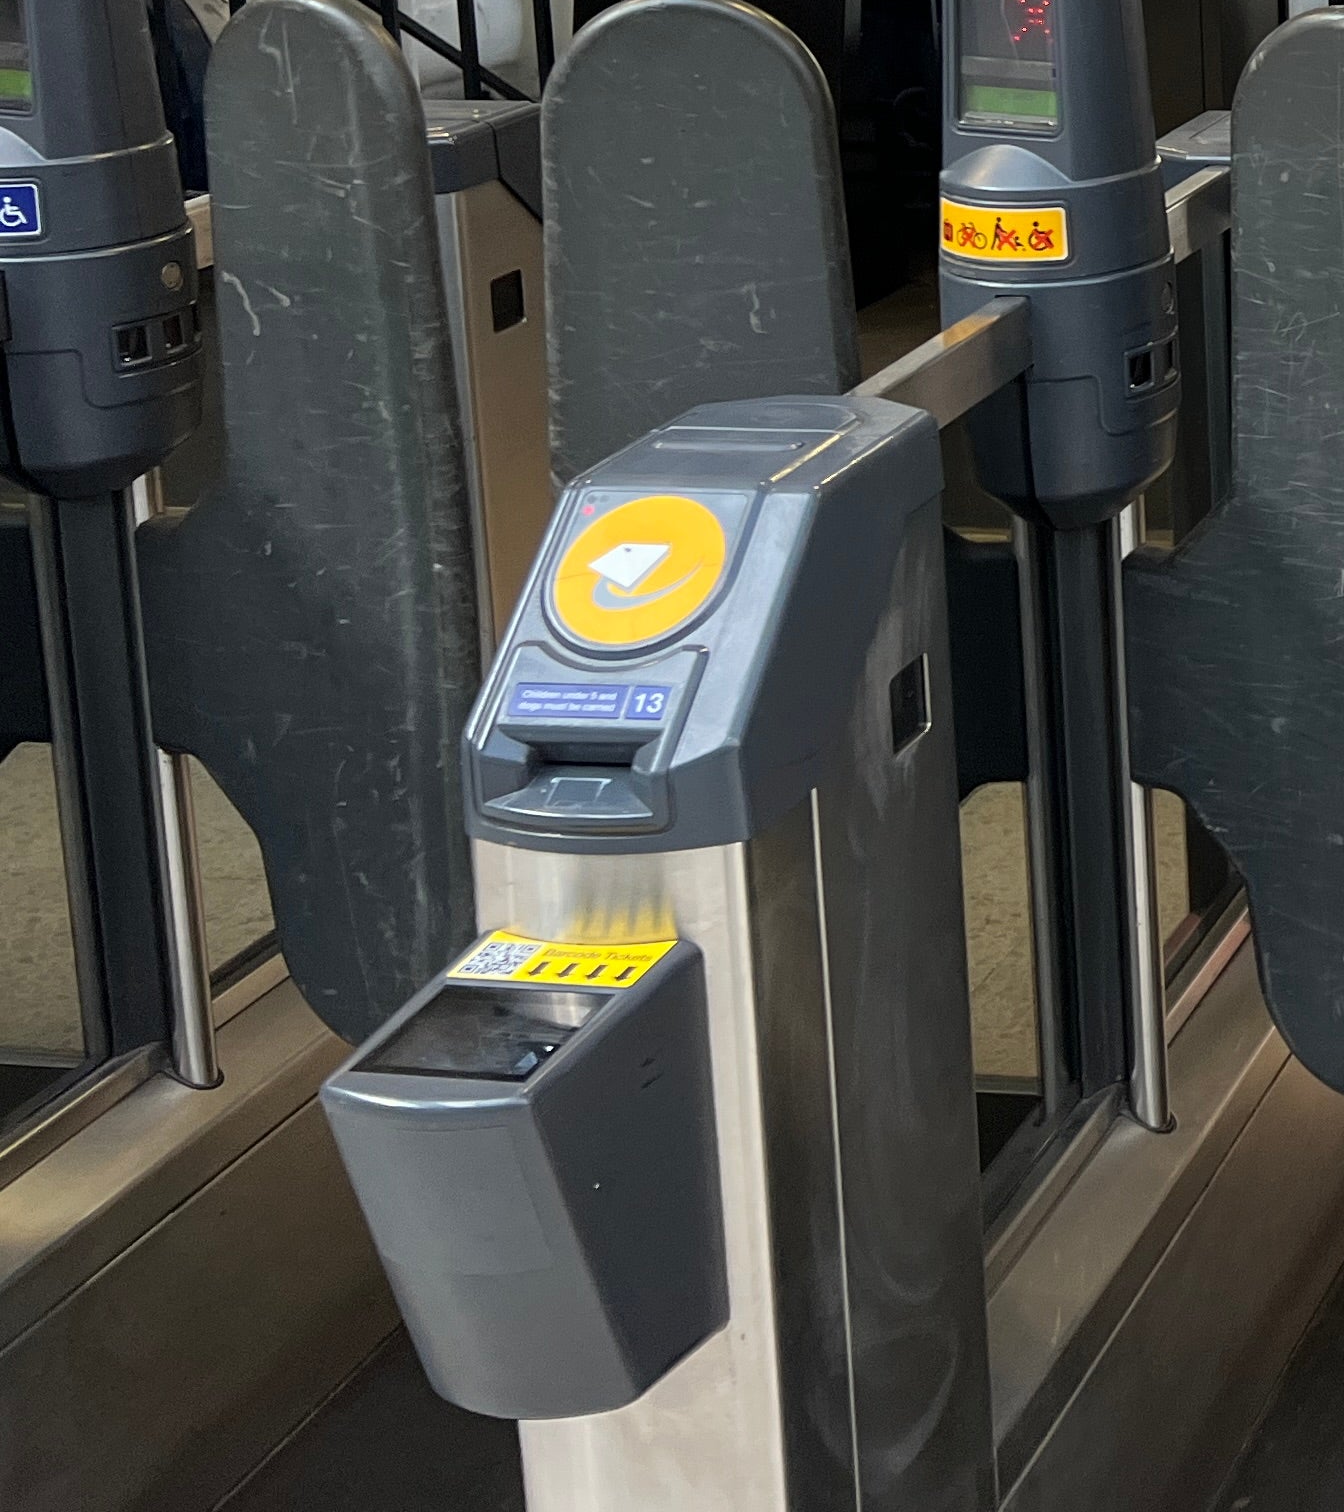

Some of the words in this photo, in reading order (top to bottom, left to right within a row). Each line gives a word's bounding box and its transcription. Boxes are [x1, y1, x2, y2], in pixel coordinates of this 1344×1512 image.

[635, 692, 664, 713] 13
[542, 949, 602, 960] Barcode
[604, 951, 653, 962] Tickets
